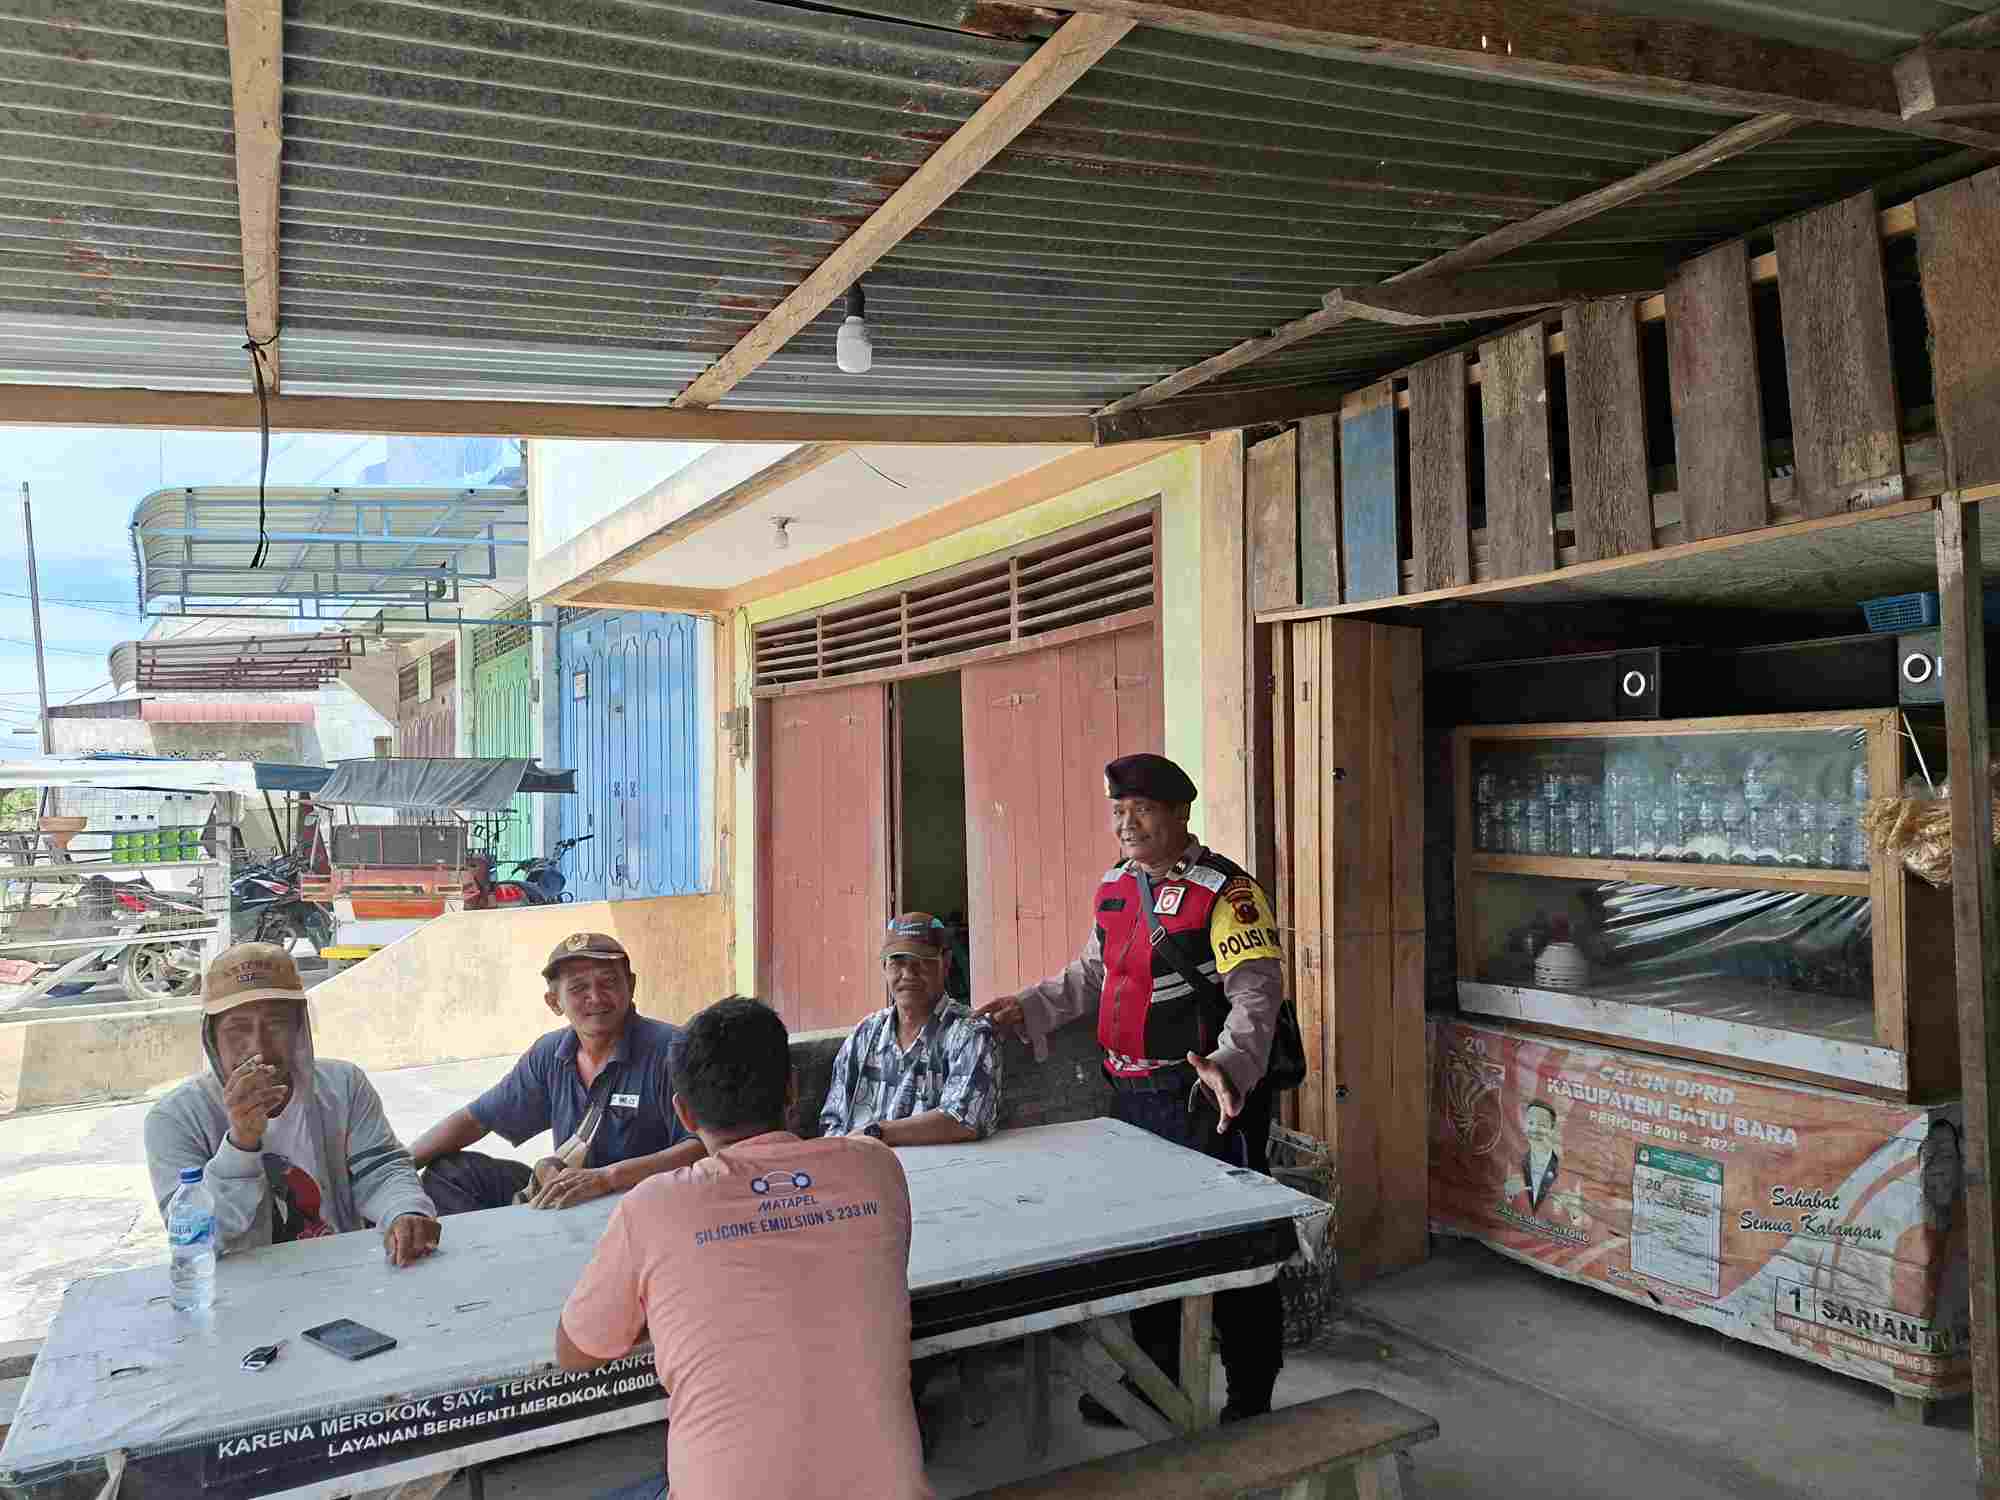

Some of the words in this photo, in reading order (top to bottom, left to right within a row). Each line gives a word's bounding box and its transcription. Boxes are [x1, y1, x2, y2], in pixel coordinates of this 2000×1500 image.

[1219, 927, 1266, 960] POLISI
[1547, 1077, 1663, 1117] KABUPATEN
[1668, 1103, 1729, 1130] BATU
[1734, 1116, 1798, 1149] BARA
[1589, 1110, 1650, 1136] PERIODE
[758, 1195, 819, 1213] MATAPEL
[1771, 1187, 1841, 1211] Sahabat
[760, 1211, 824, 1234] EMULSION
[1740, 1210, 1793, 1233] Semua
[1800, 1214, 1883, 1242] Kalangan
[217, 1424, 315, 1460] KARENA
[321, 1400, 436, 1438] MEROKOK,
[442, 1391, 494, 1412] SAYA
[499, 1371, 590, 1399] TERKENA
[328, 1424, 417, 1458] LAYANAN
[423, 1405, 516, 1436] BERHENTI
[519, 1385, 609, 1417] MEROKOK
